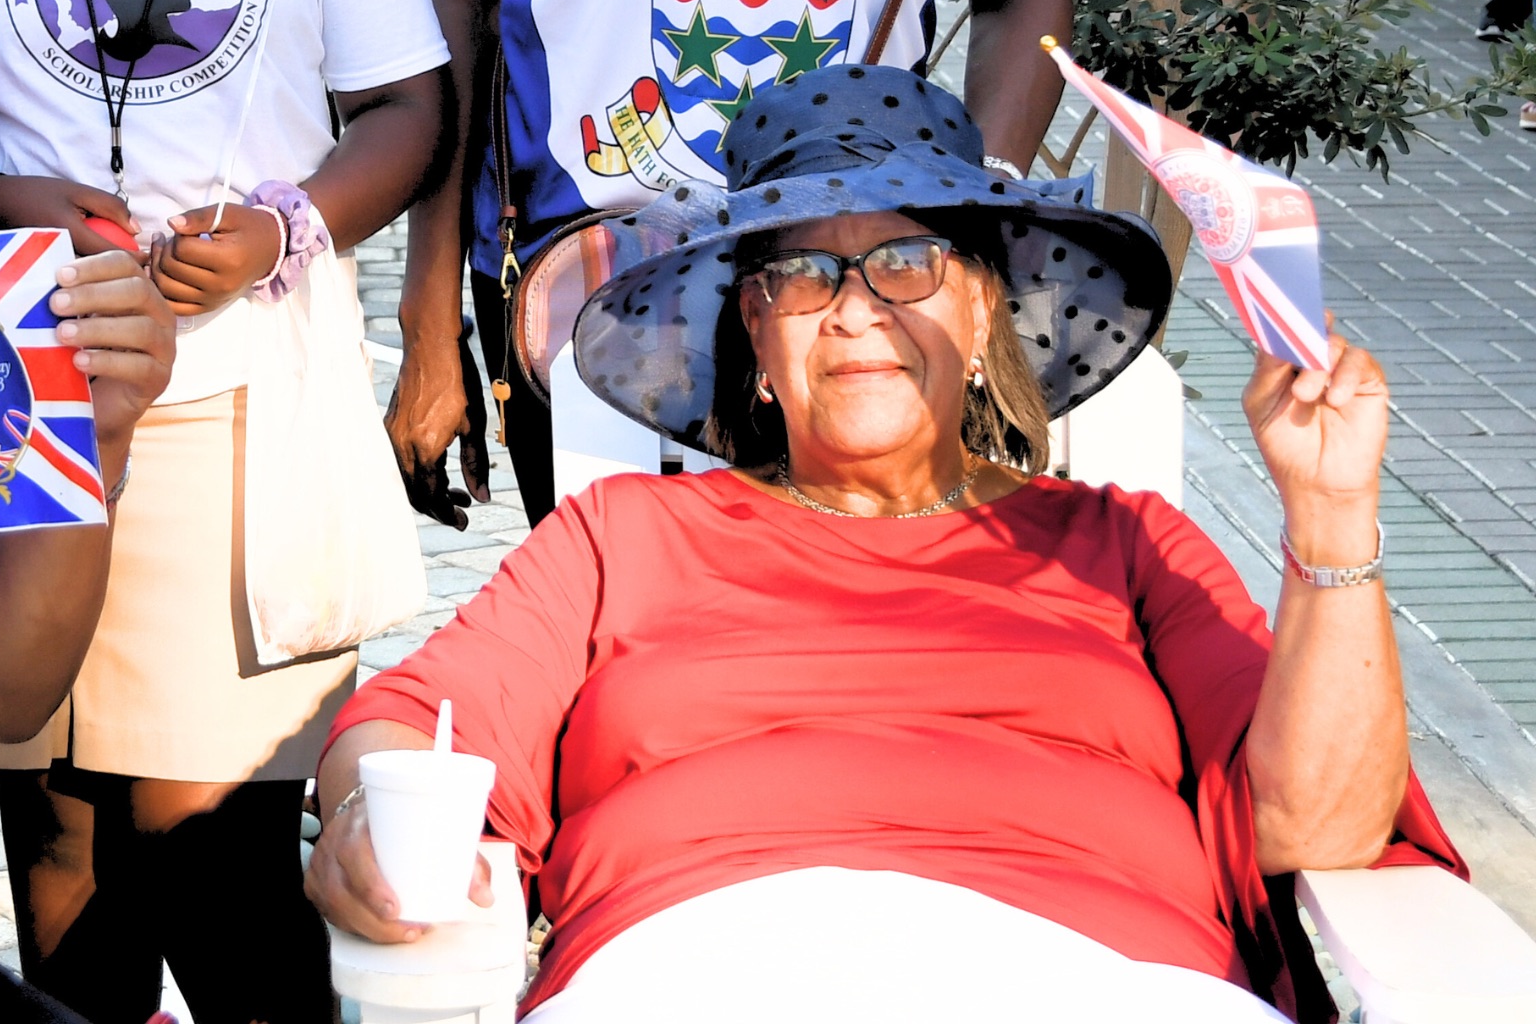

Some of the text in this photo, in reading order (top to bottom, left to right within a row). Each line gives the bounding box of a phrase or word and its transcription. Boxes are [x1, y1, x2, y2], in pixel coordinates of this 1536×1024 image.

[42, 1, 258, 100] SCHOLARSHIP COMPETITION
[614, 104, 635, 132] HE
[627, 131, 657, 177] HATH
